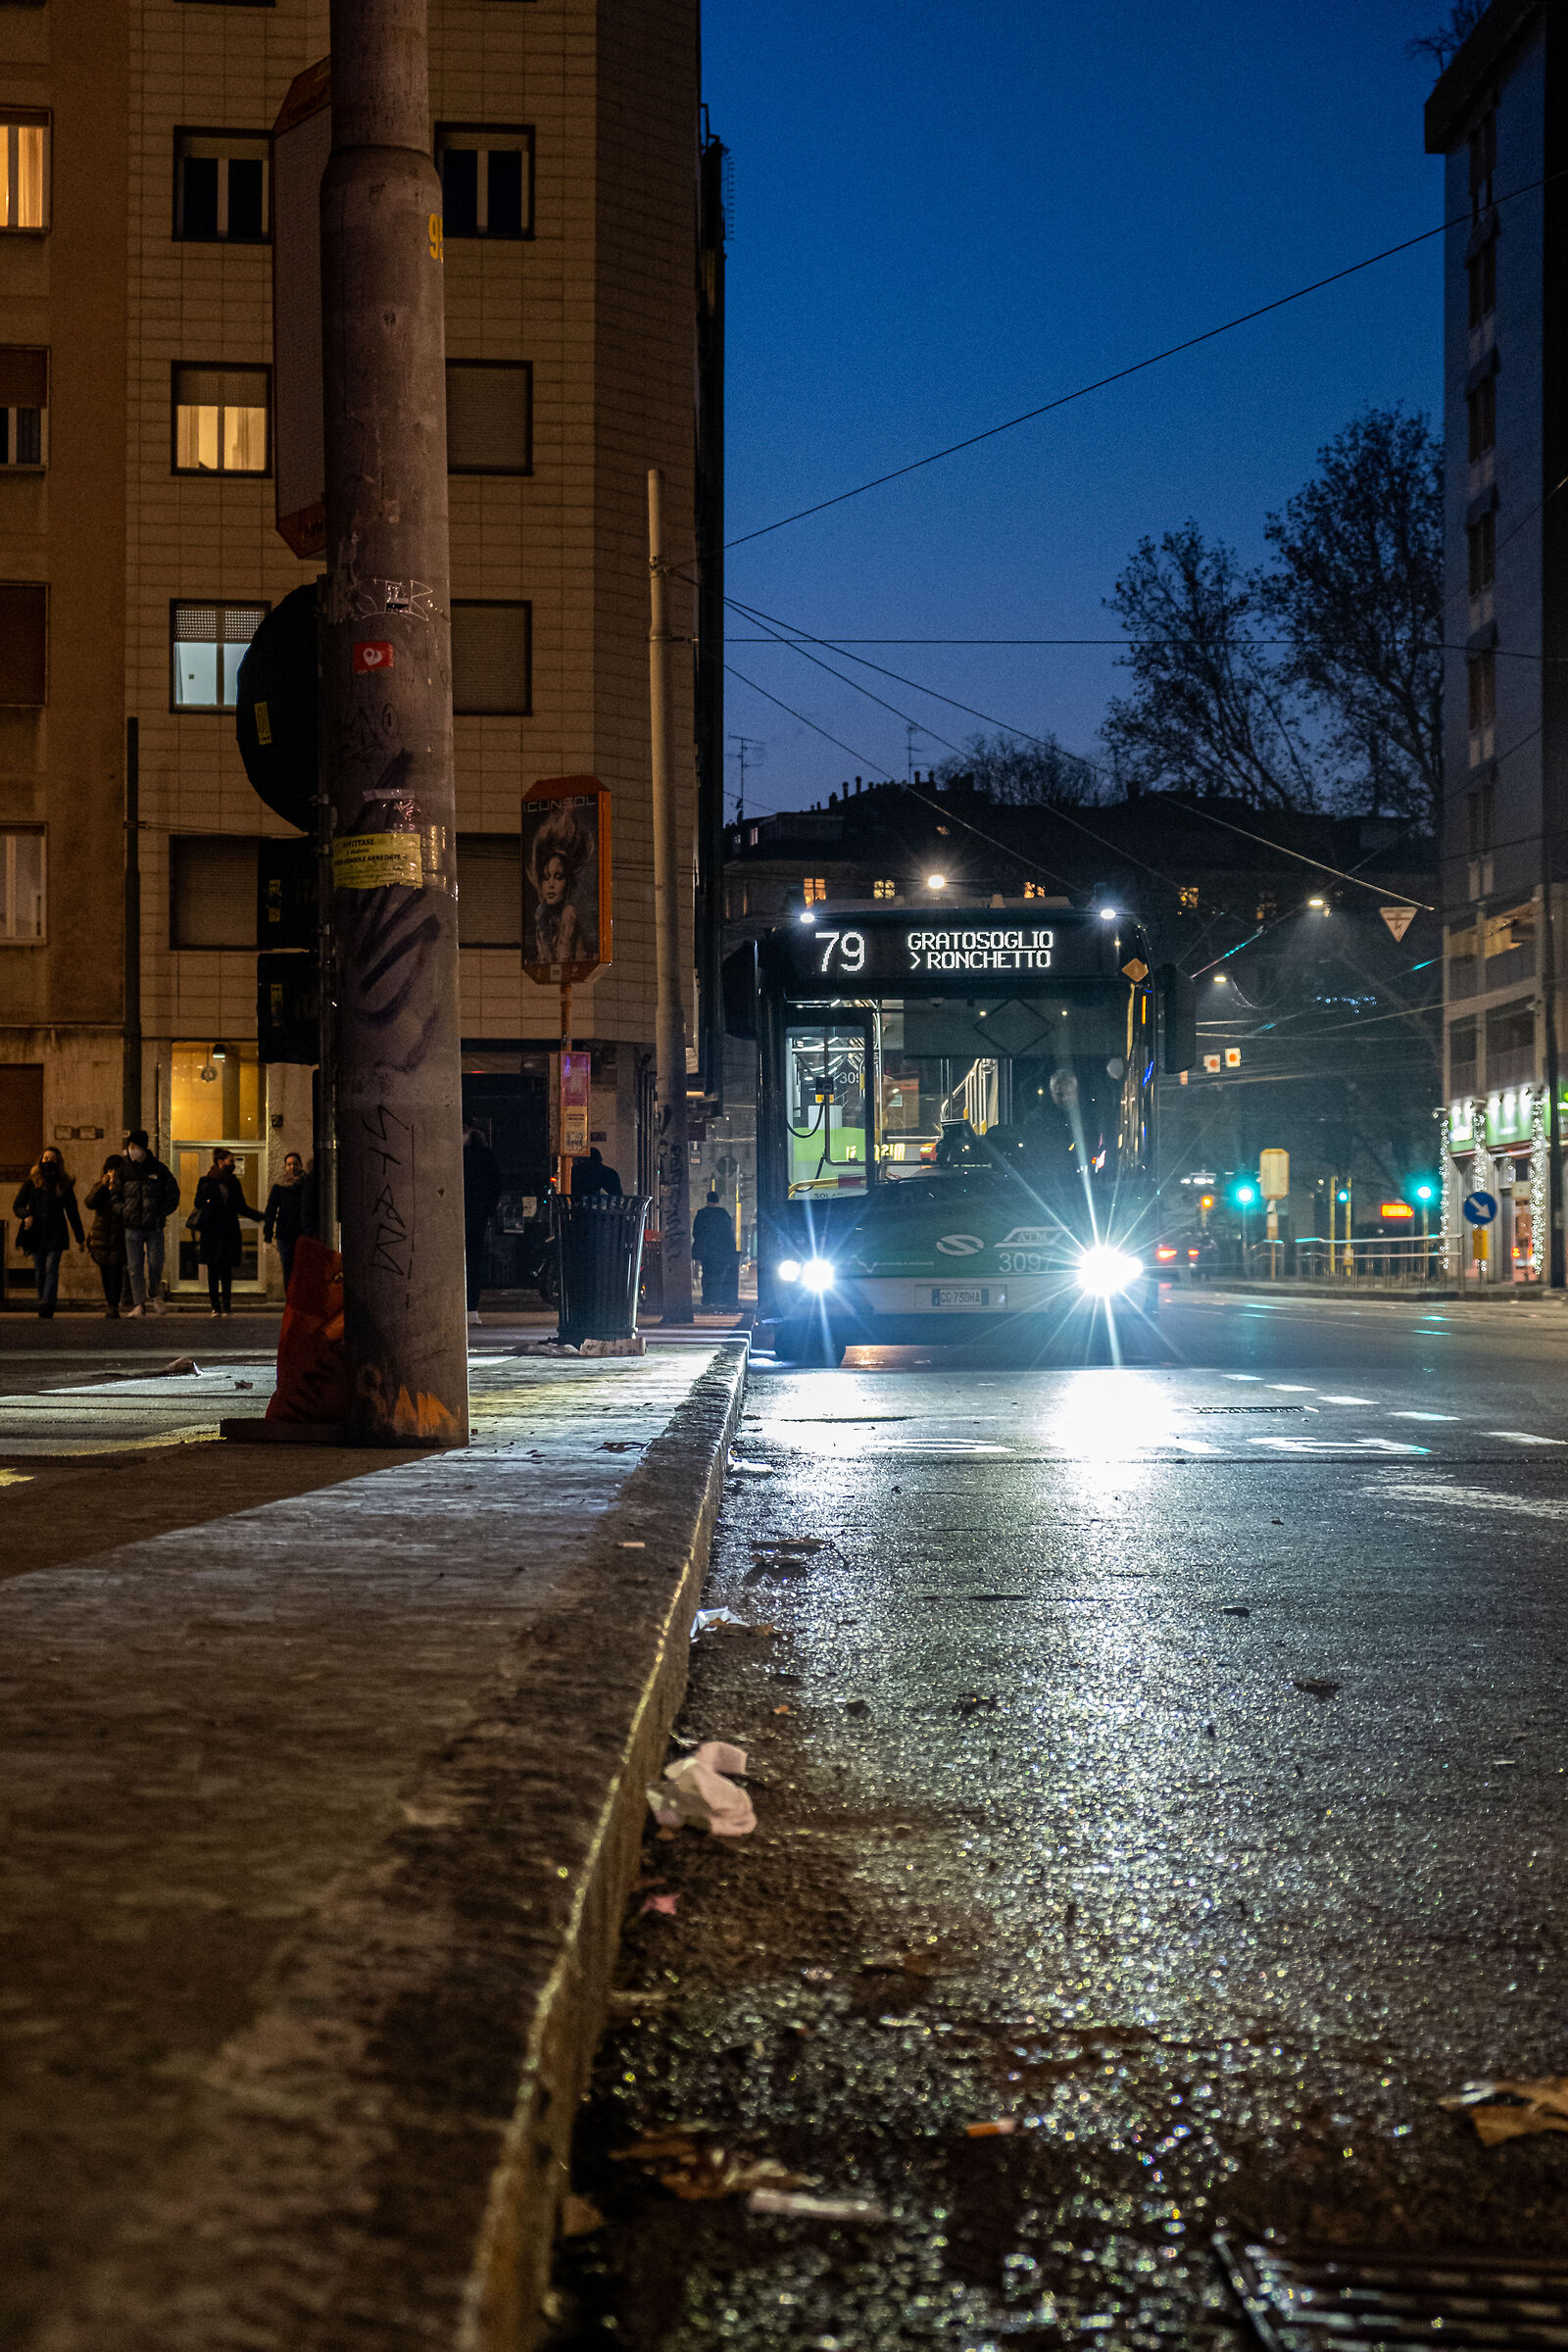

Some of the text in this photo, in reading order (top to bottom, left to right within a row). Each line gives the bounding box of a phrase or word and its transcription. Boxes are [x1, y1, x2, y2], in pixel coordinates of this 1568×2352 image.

[815, 930, 1054, 972] 79 GRATOSOGLIO
[927, 951, 1052, 969] RONCHETTO
[1017, 1231, 1048, 1243] ATM
[999, 1251, 1053, 1273] 3097
